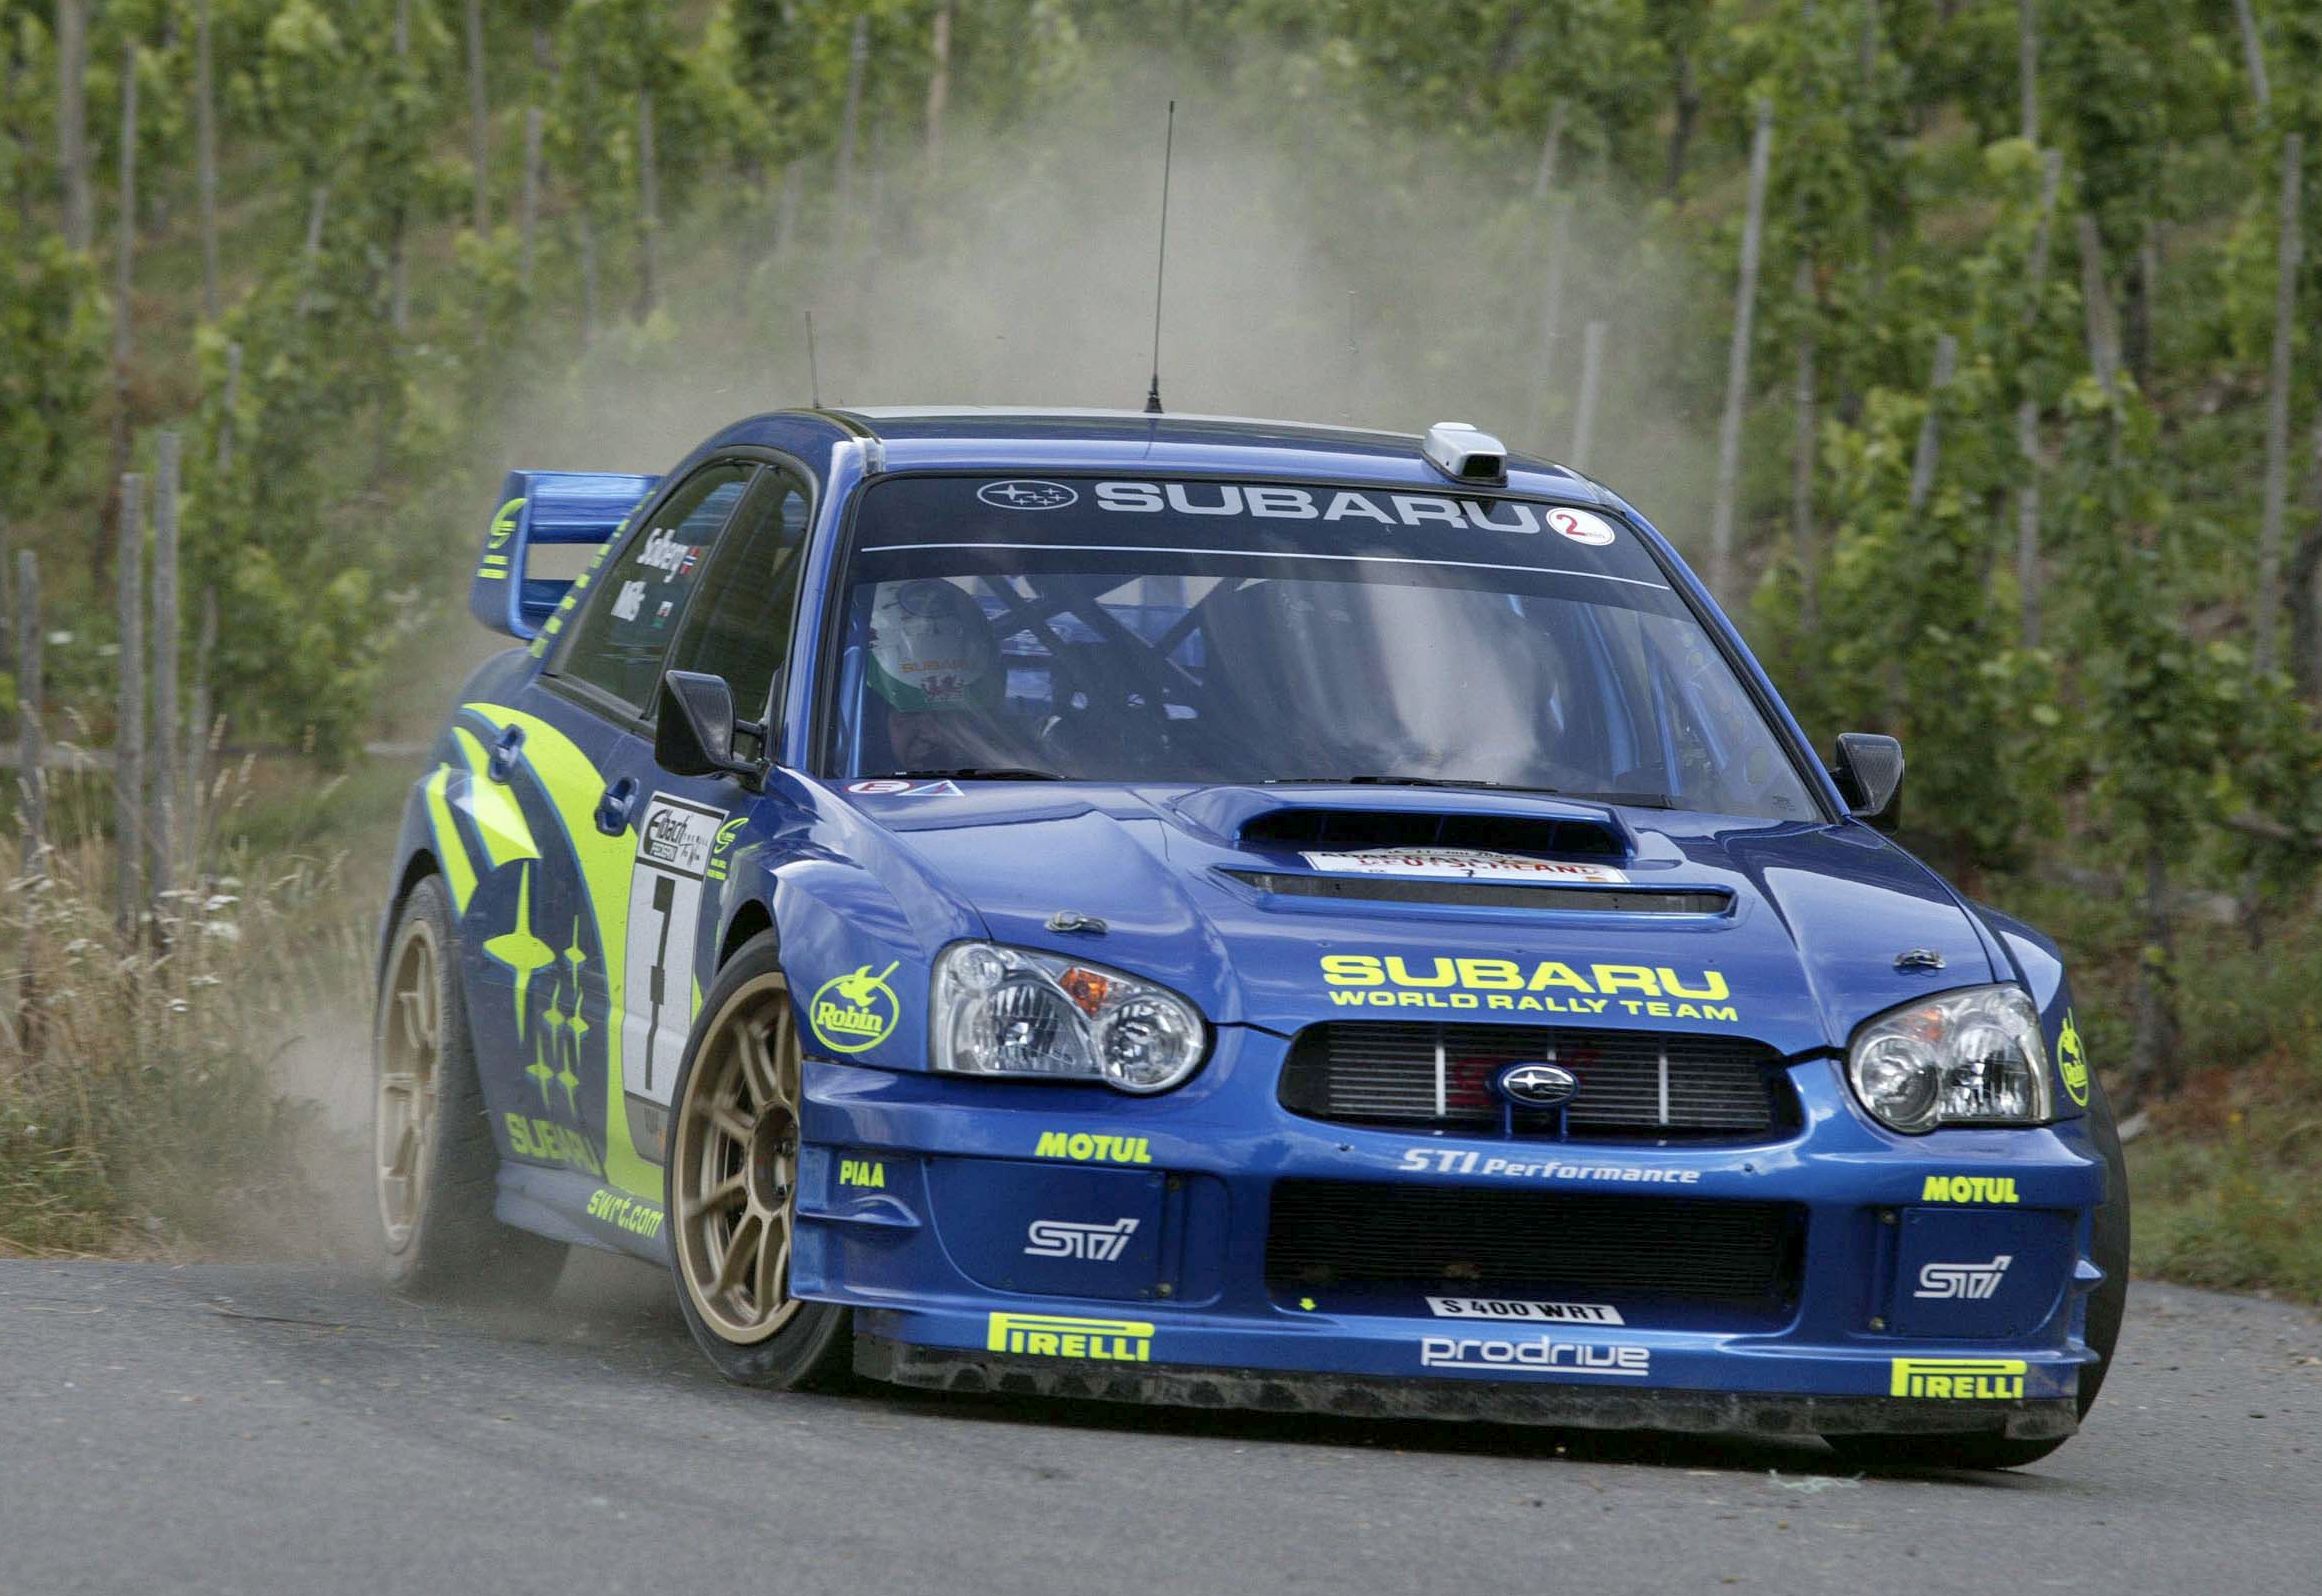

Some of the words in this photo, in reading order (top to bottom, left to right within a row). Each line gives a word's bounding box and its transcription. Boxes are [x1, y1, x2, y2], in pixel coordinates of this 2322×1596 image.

[1096, 481, 1541, 535] SUBARU
[1556, 514, 1585, 536] 2
[644, 875, 676, 1091] 7
[1320, 955, 1730, 1001] SUBARU
[817, 1001, 884, 1036] Robin
[1327, 990, 1478, 1009] WORLD
[1487, 994, 1609, 1014] RALLY
[1618, 1000, 1739, 1022] TEAM
[1035, 1131, 1152, 1164] MOTUL
[840, 1160, 885, 1187] PIAA
[1399, 1148, 1480, 1174] STI
[1483, 1158, 1700, 1183] Performance
[1922, 1176, 2019, 1203] MOTUL
[586, 1188, 664, 1239] swrt.com
[1444, 1300, 1460, 1314] S
[1469, 1301, 1530, 1317] 400
[1534, 1303, 1607, 1321] WRT
[987, 1311, 1156, 1362] PIRELLI
[1420, 1334, 1650, 1372] prodrive
[1890, 1357, 2028, 1399] PIRELLI
